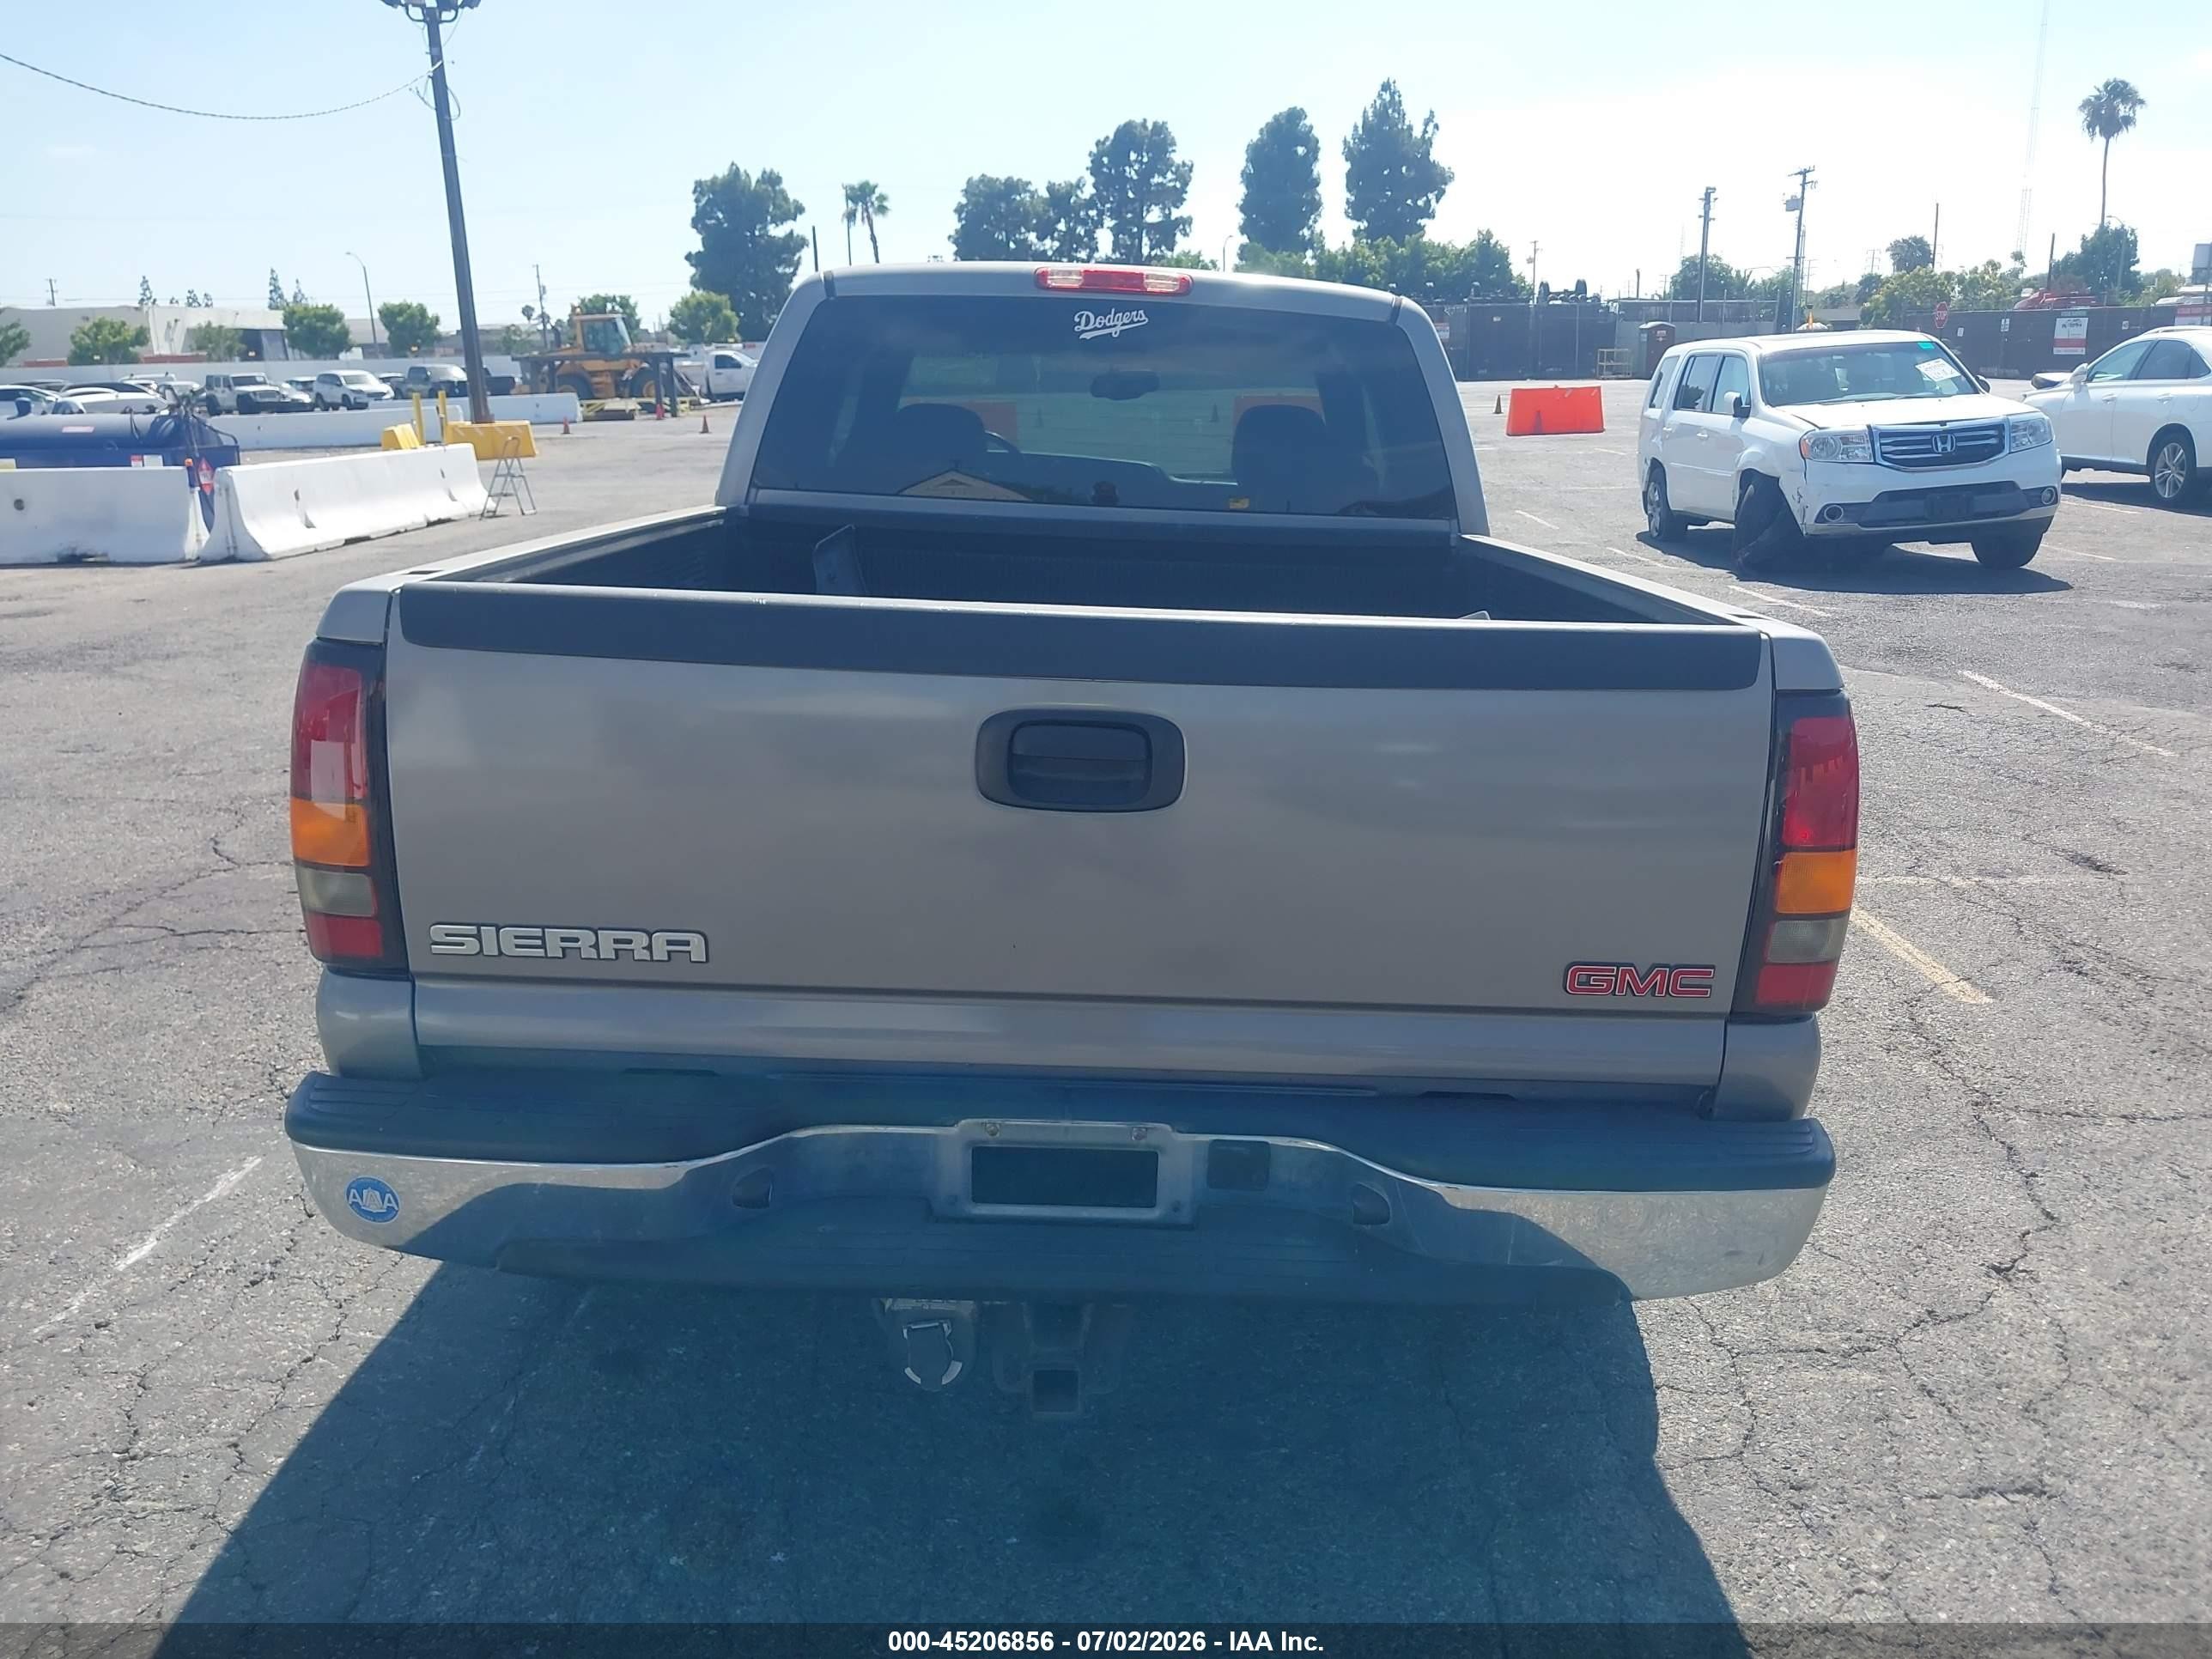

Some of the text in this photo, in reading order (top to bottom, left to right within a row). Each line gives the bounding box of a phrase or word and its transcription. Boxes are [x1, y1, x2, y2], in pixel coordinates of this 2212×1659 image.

[1073, 307, 1149, 339] Dodgers
[429, 924, 707, 963] SIERRA
[1565, 963, 1715, 998] GMC
